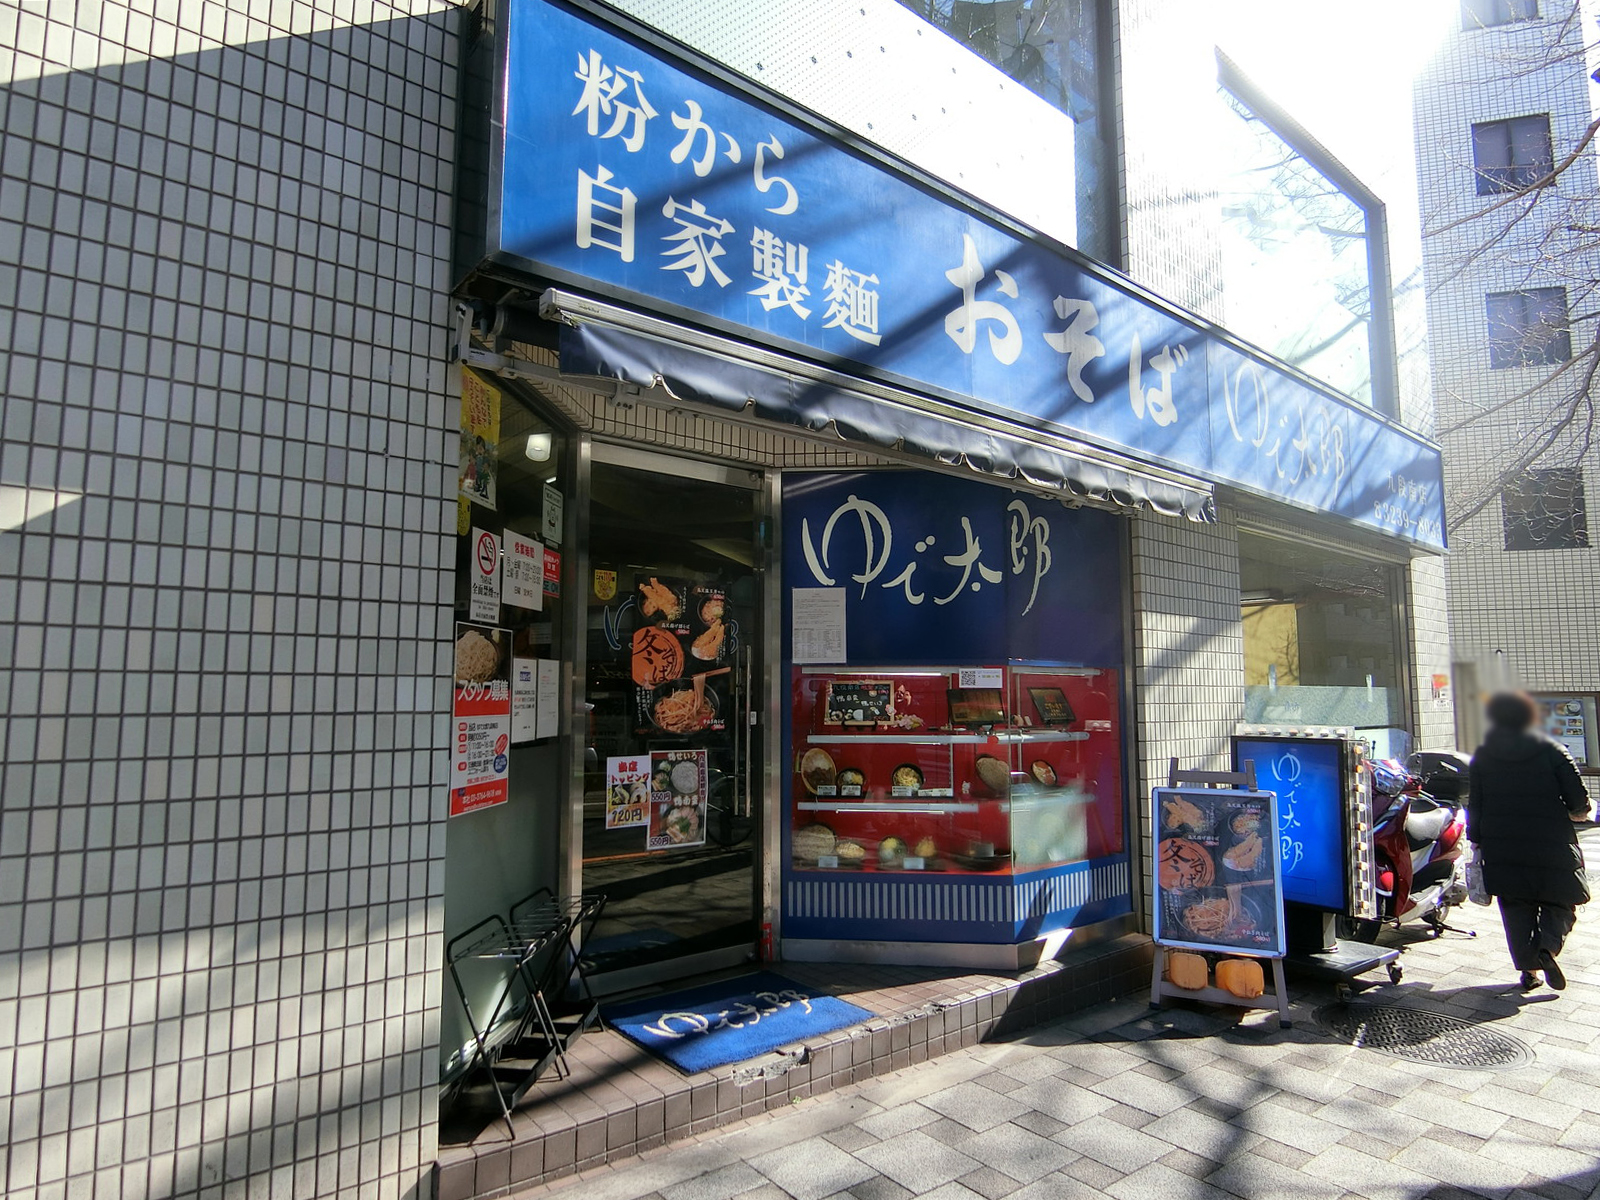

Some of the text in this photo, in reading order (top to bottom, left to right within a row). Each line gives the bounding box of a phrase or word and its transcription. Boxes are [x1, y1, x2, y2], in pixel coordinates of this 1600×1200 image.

[572, 48, 799, 216] 粉から
[945, 233, 1189, 428] おそば
[1223, 358, 1345, 511] ゆで太郎
[802, 494, 1052, 616] ゆで太郎
[458, 679, 509, 701] スタッフ募集
[611, 772, 650, 784] トッピング
[667, 751, 698, 761] 鴨せいろ
[1271, 752, 1304, 873] ゆで太郎
[642, 989, 813, 1038] ゆで太郎
